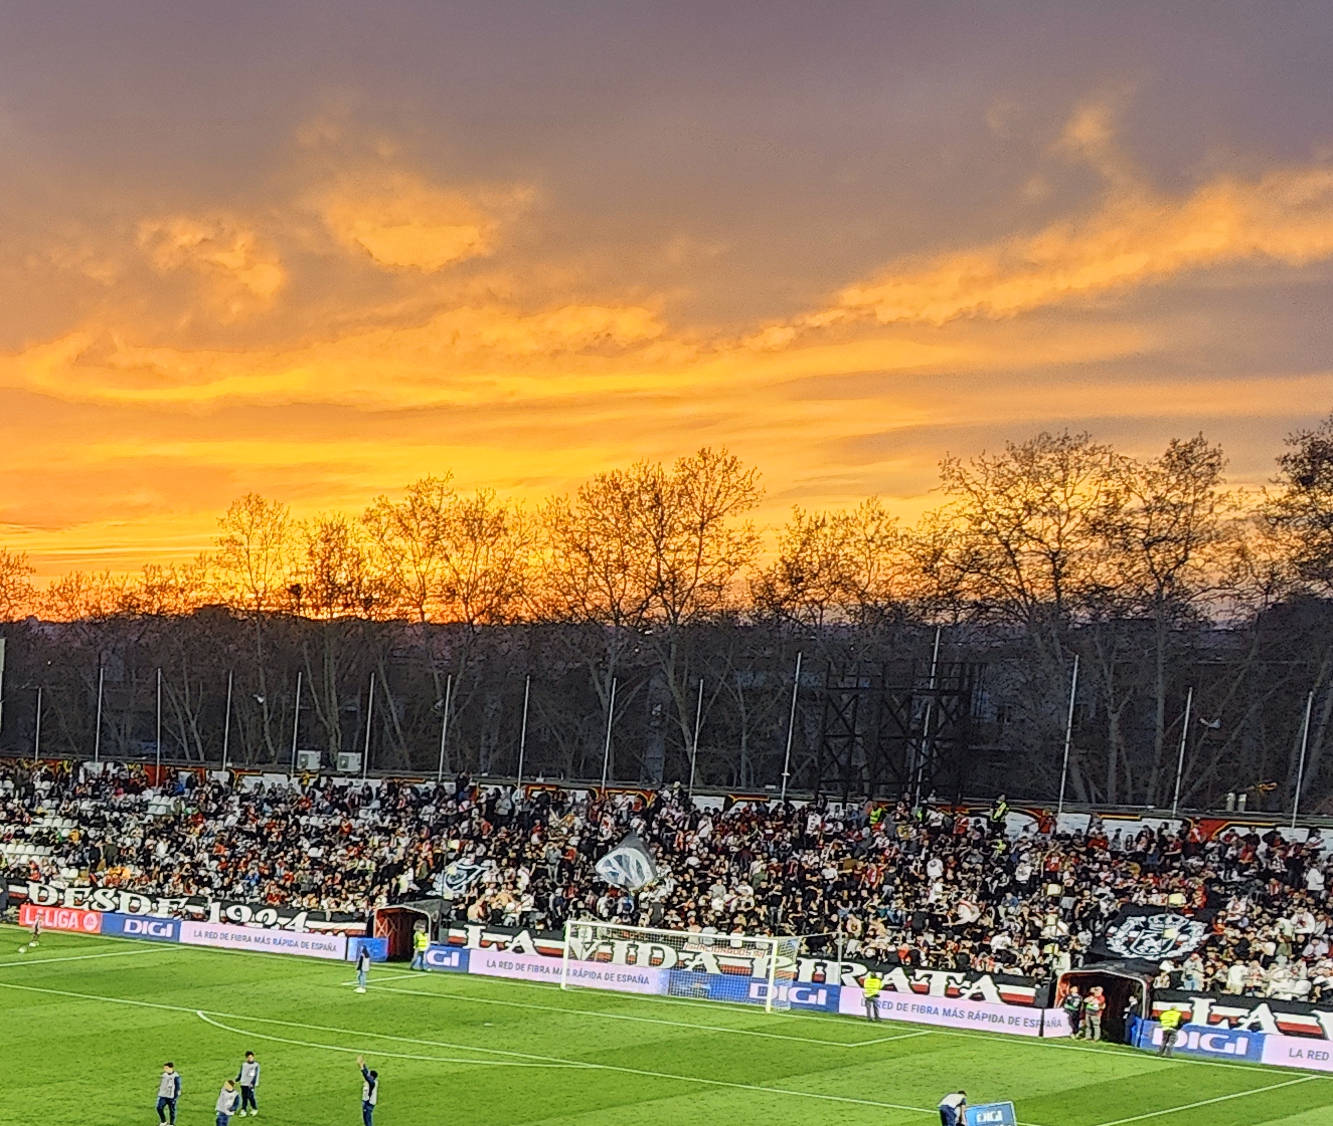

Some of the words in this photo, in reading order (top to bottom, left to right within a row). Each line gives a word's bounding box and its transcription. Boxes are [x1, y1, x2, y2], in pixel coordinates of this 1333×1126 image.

[26, 881, 189, 920] DESDE
[208, 902, 310, 933] 1924
[123, 919, 173, 937] DIGI
[463, 924, 539, 954] LA
[193, 929, 203, 938] LA
[204, 931, 218, 940] RED
[220, 932, 229, 941] DE
[231, 933, 252, 943] FIBRA
[254, 933, 271, 945] MÁS
[272, 936, 300, 948] RÁPIDA
[301, 941, 311, 949] DE
[311, 941, 337, 952] ESPAÑA
[426, 950, 460, 967] GI
[486, 959, 496, 968] LA
[499, 961, 513, 970] RED
[515, 963, 525, 971] DE
[527, 963, 550, 974] FIBRA
[572, 968, 602, 980] RÁPIDA
[604, 973, 616, 981] DE
[617, 973, 649, 985] ESPAÑA
[749, 982, 827, 1005] DIGI
[897, 1002, 909, 1012] DE
[911, 1004, 939, 1016] FIBRA
[942, 1005, 965, 1020] MÁS
[967, 1008, 1005, 1024] RÁPIDA
[1008, 1016, 1021, 1026] DE
[1183, 997, 1285, 1035] LA
[1152, 1028, 1249, 1055] DIGI
[1288, 1047, 1303, 1058] LA
[1307, 1049, 1330, 1061] RED
